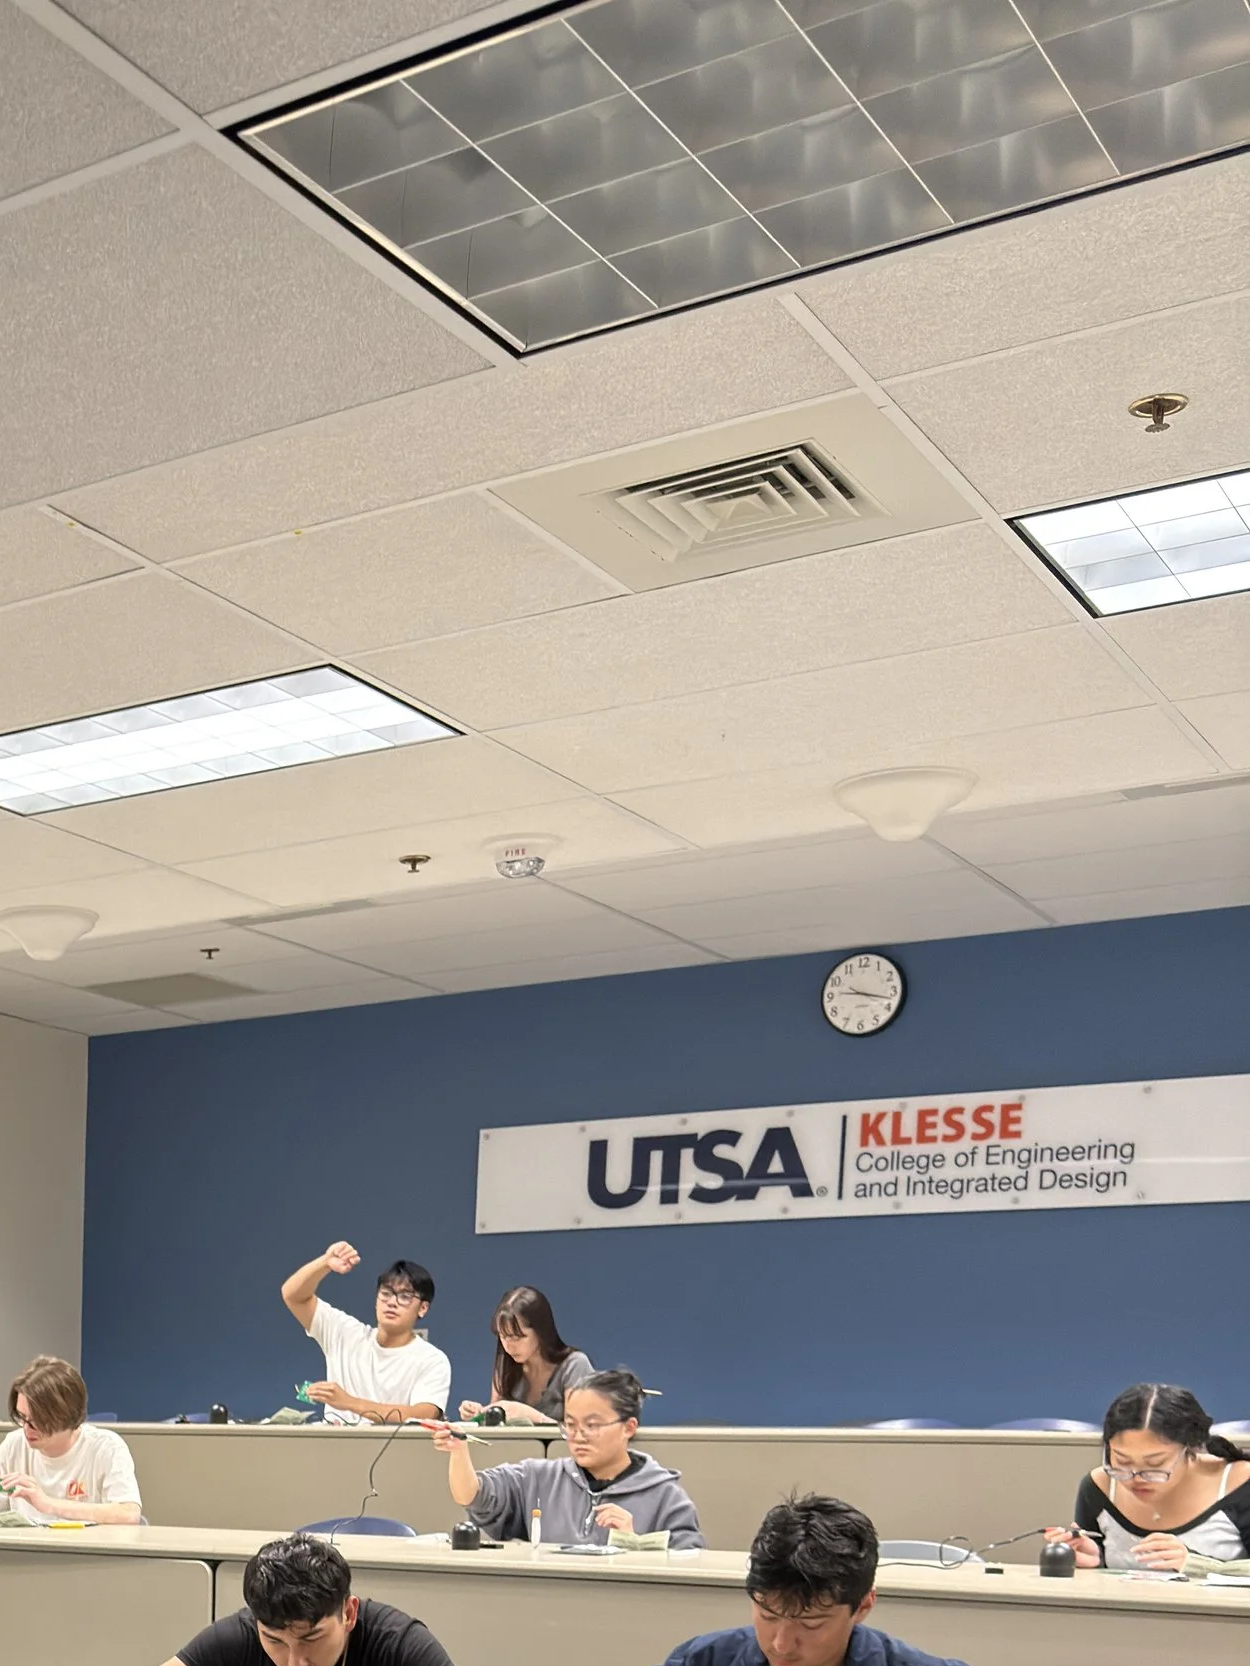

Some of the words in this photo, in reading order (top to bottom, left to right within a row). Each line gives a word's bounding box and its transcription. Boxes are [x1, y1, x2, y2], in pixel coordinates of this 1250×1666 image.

[858, 957, 870, 968] 12
[876, 961, 881, 971] 1
[845, 964, 853, 975] 11
[830, 976, 842, 987] 10
[886, 971, 894, 982] 2
[890, 986, 898, 997] 3
[827, 992, 834, 1003] 9
[830, 1006, 838, 1017] 8
[884, 1002, 892, 1012] 4
[842, 1017, 850, 1028] 7
[857, 1020, 864, 1030] 6
[872, 1015, 880, 1026] 5
[859, 1102, 1023, 1148] KLESSE
[855, 1150, 946, 1175] College
[954, 1146, 980, 1168] of
[985, 1138, 1136, 1165] Engineering
[587, 1126, 815, 1209] UTSA
[854, 1177, 899, 1199] and
[906, 1170, 1029, 1200] Integrated
[1039, 1167, 1128, 1193] Design
